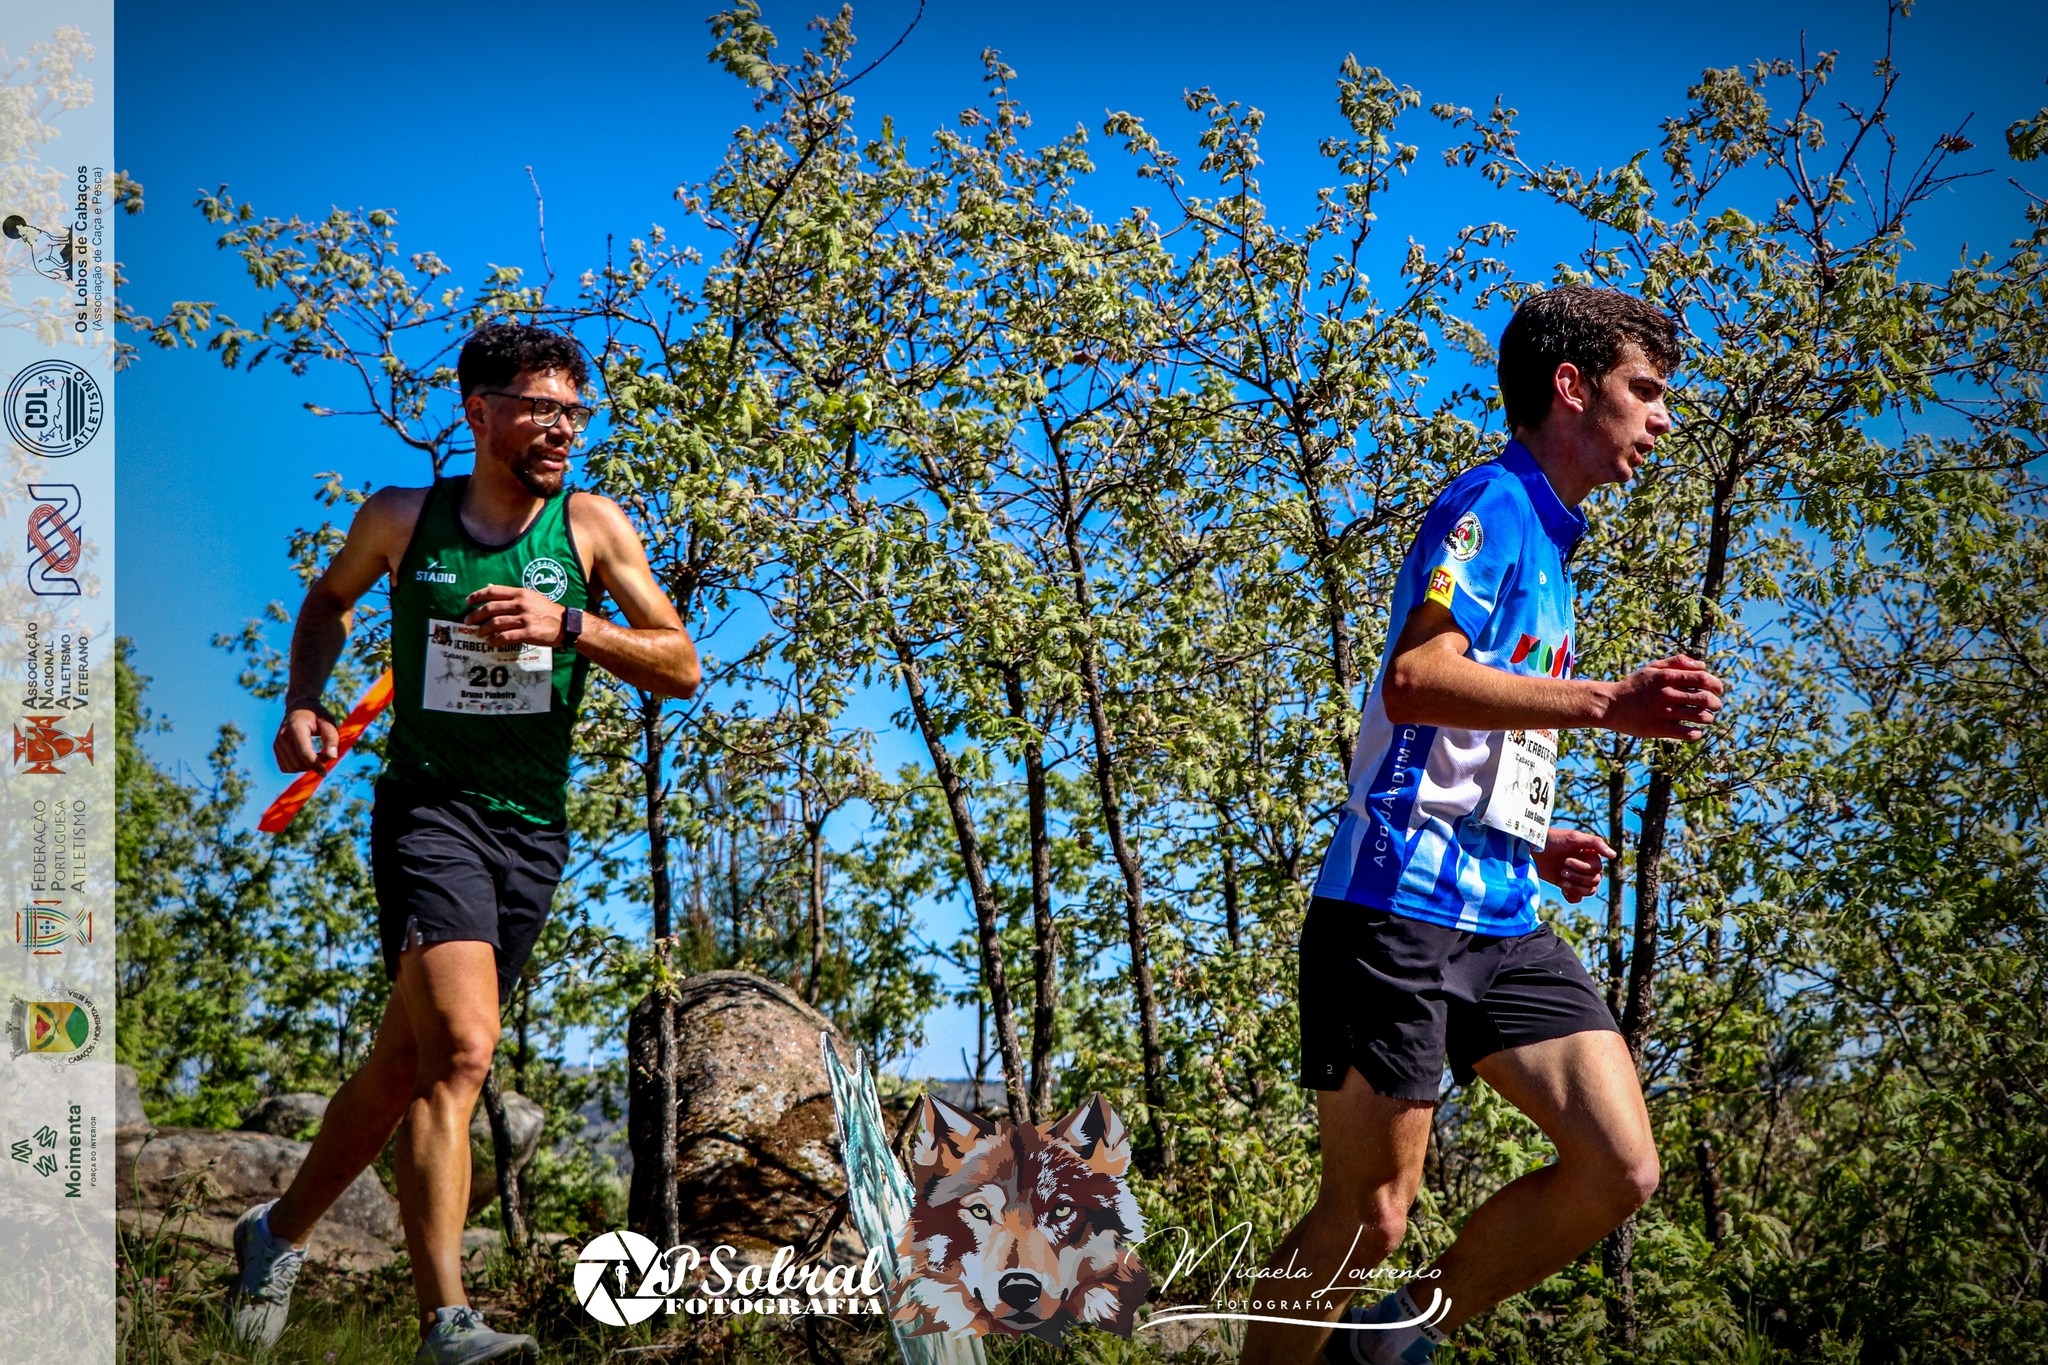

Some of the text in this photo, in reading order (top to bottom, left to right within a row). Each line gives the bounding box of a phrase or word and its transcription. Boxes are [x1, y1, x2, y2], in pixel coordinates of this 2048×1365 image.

[416, 571, 456, 584] STADIO
[469, 666, 509, 688] 20
[1380, 747, 1411, 820] JARDIM
[1530, 777, 1549, 810] 34
[1373, 825, 1389, 867] ACD
[1400, 1298, 1438, 1340] KIPUN
